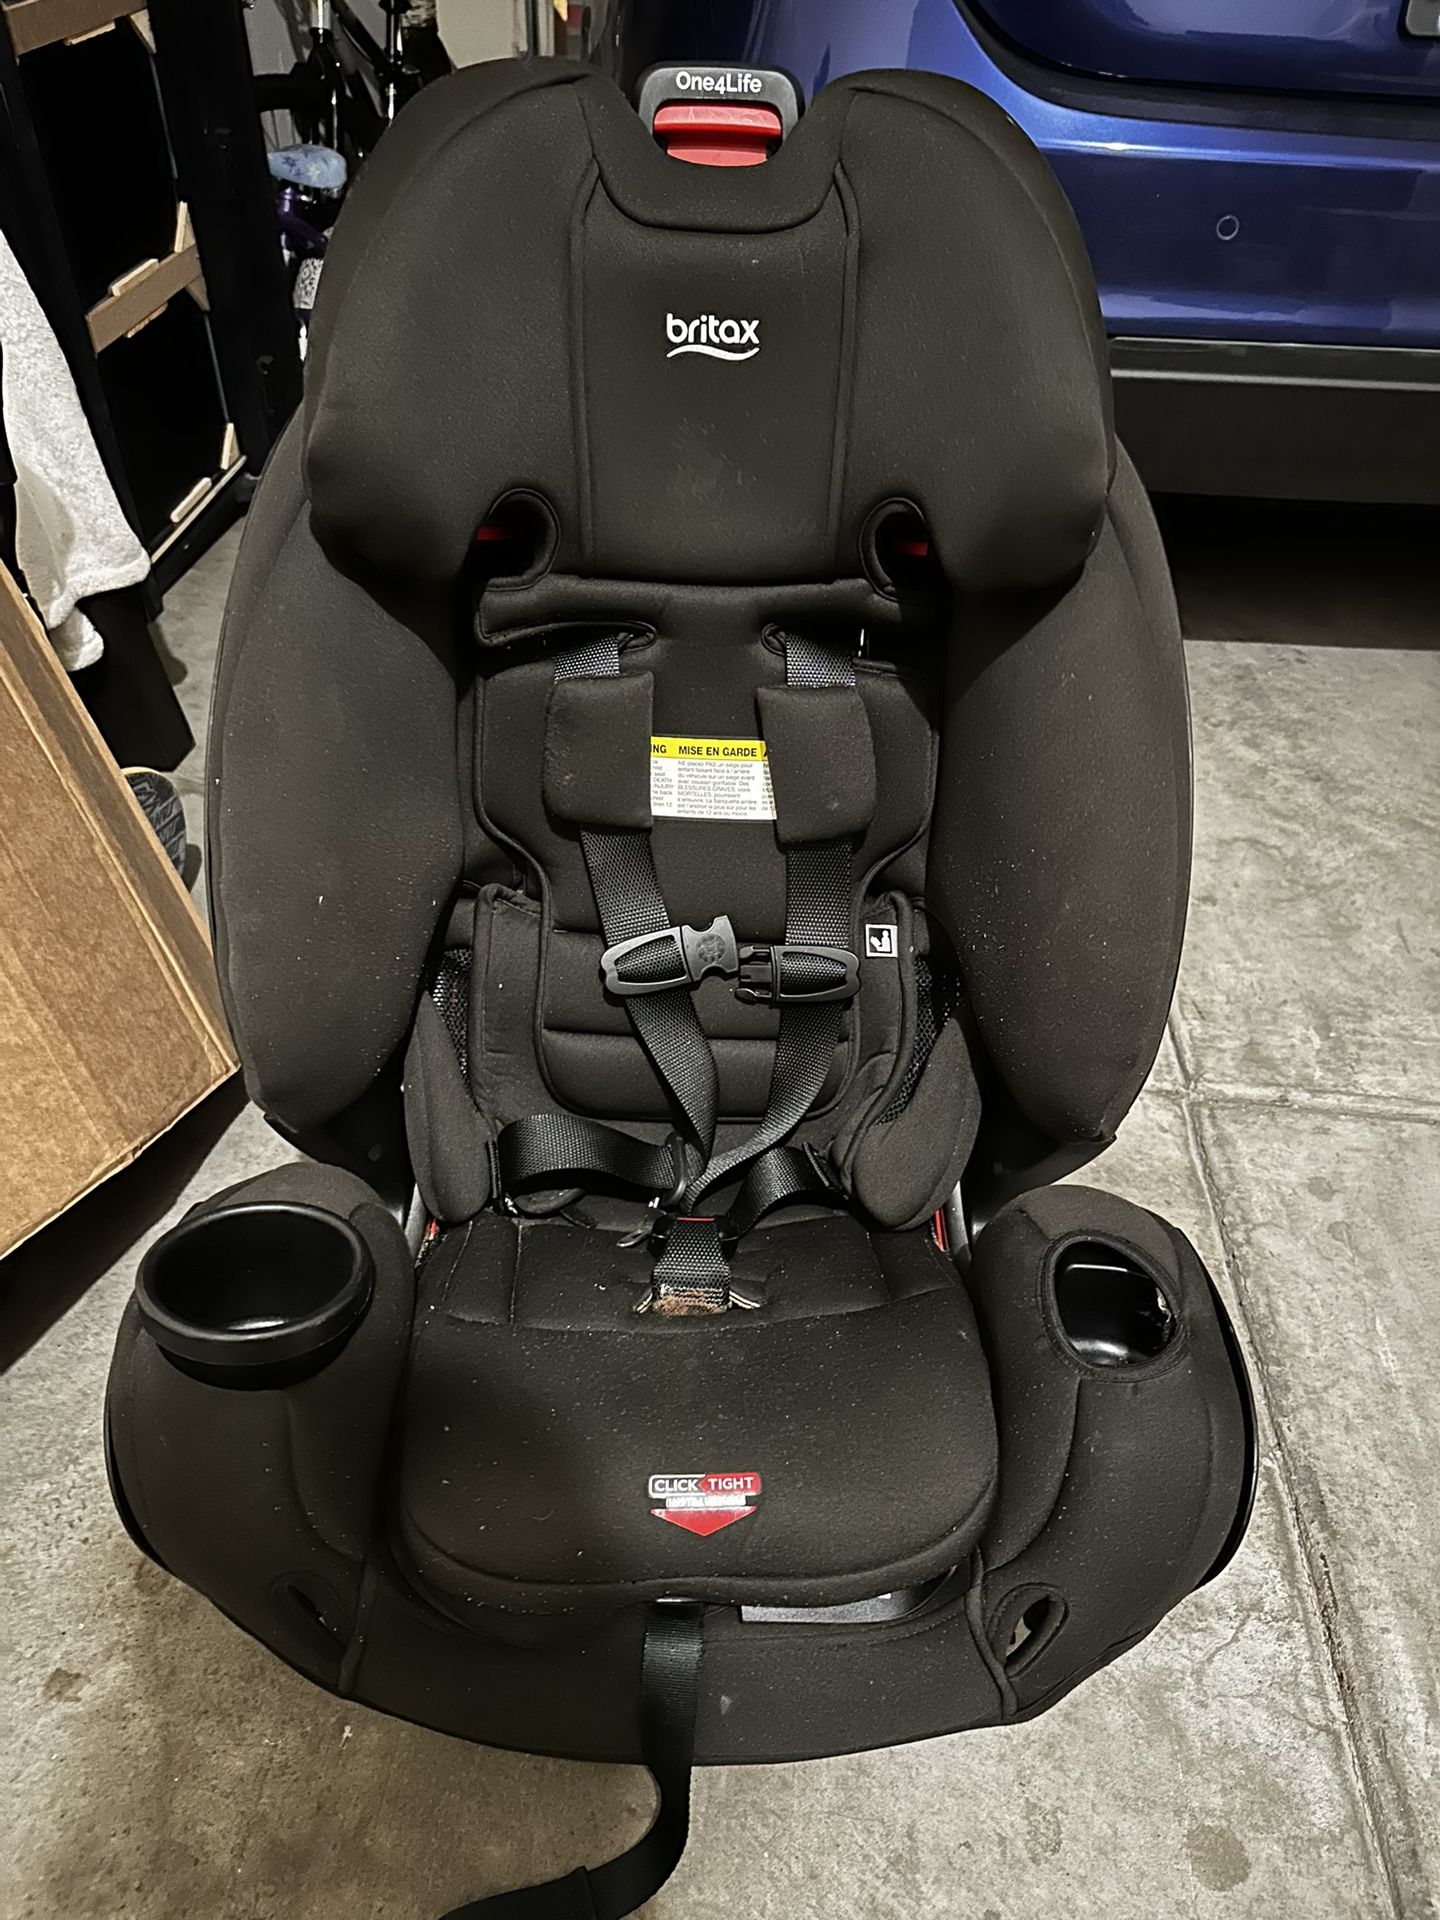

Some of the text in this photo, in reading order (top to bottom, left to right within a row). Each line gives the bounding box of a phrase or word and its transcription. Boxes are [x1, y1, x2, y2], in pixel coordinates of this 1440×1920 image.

[676, 71, 762, 94] One4Life
[666, 313, 760, 344] britax
[679, 745, 703, 755] MISE
[706, 747, 720, 756] EN
[722, 747, 757, 757] GARDE
[654, 1476, 754, 1492] CLICK TIGHT
